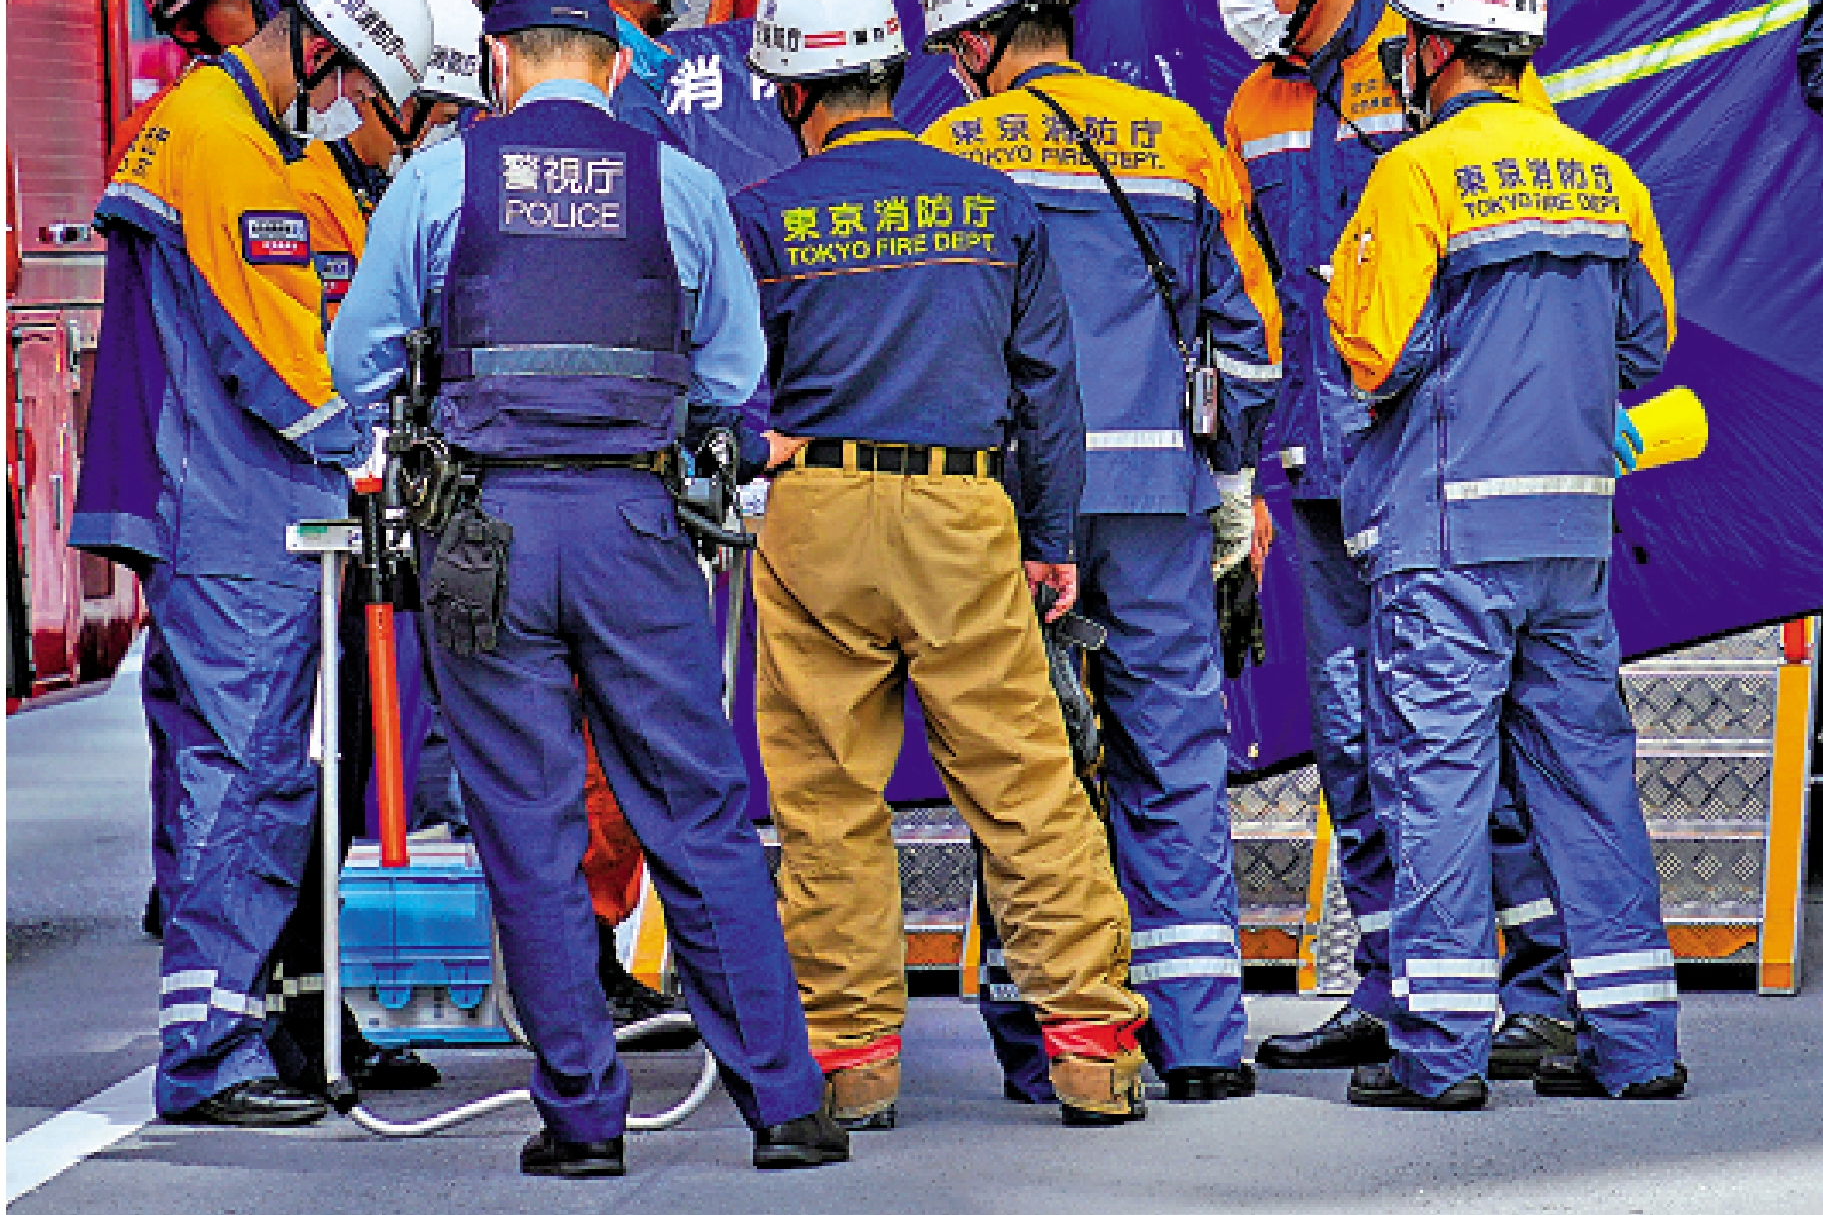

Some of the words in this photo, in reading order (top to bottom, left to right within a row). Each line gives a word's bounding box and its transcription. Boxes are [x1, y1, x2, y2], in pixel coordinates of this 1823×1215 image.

[950, 113, 1163, 149] 東京消防庁
[502, 154, 626, 196] 警視庁
[1454, 158, 1613, 201] 東京消防庁
[505, 199, 621, 228] POLICE
[781, 193, 998, 242] 東京消防庁
[1463, 193, 1533, 221] TOKYO
[787, 240, 872, 266] TOKYO
[876, 233, 929, 259] FIRE
